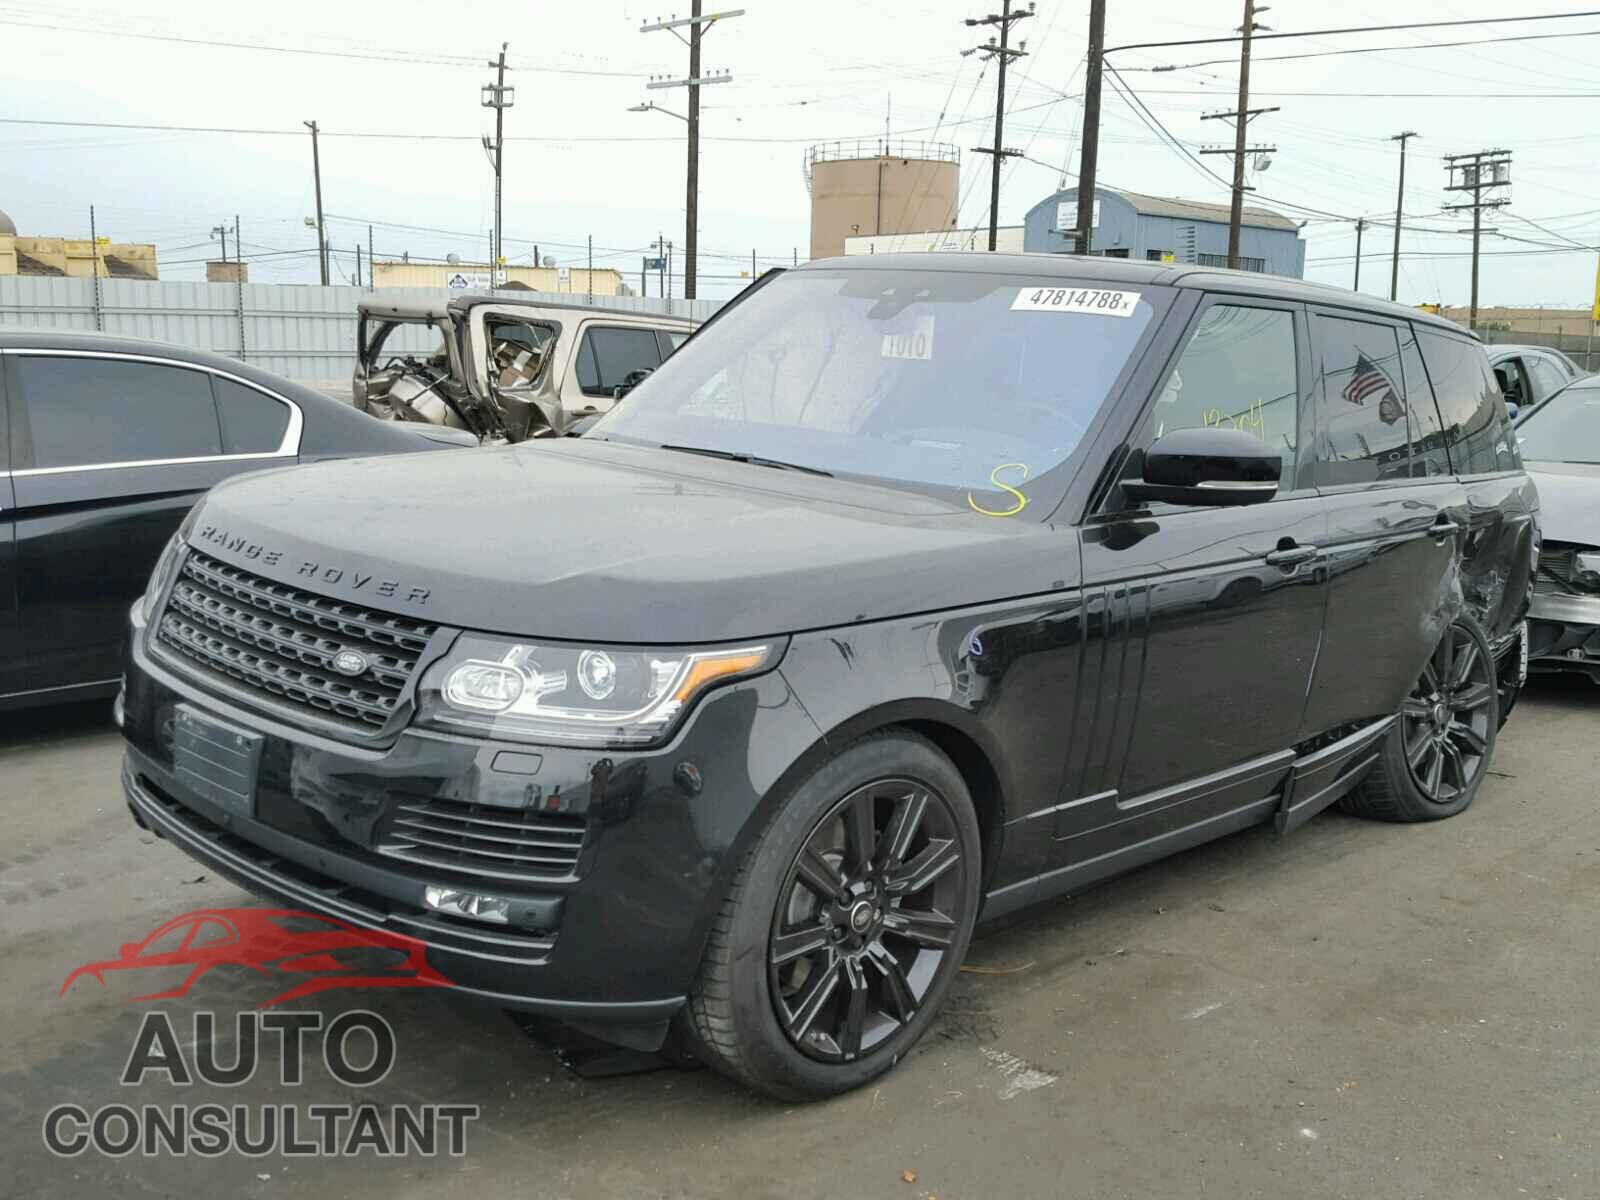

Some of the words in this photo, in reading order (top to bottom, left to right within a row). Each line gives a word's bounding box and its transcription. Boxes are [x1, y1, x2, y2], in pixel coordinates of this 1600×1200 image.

[967, 463, 1029, 516] S
[201, 526, 283, 566] RANGE
[297, 562, 431, 605] ROVER
